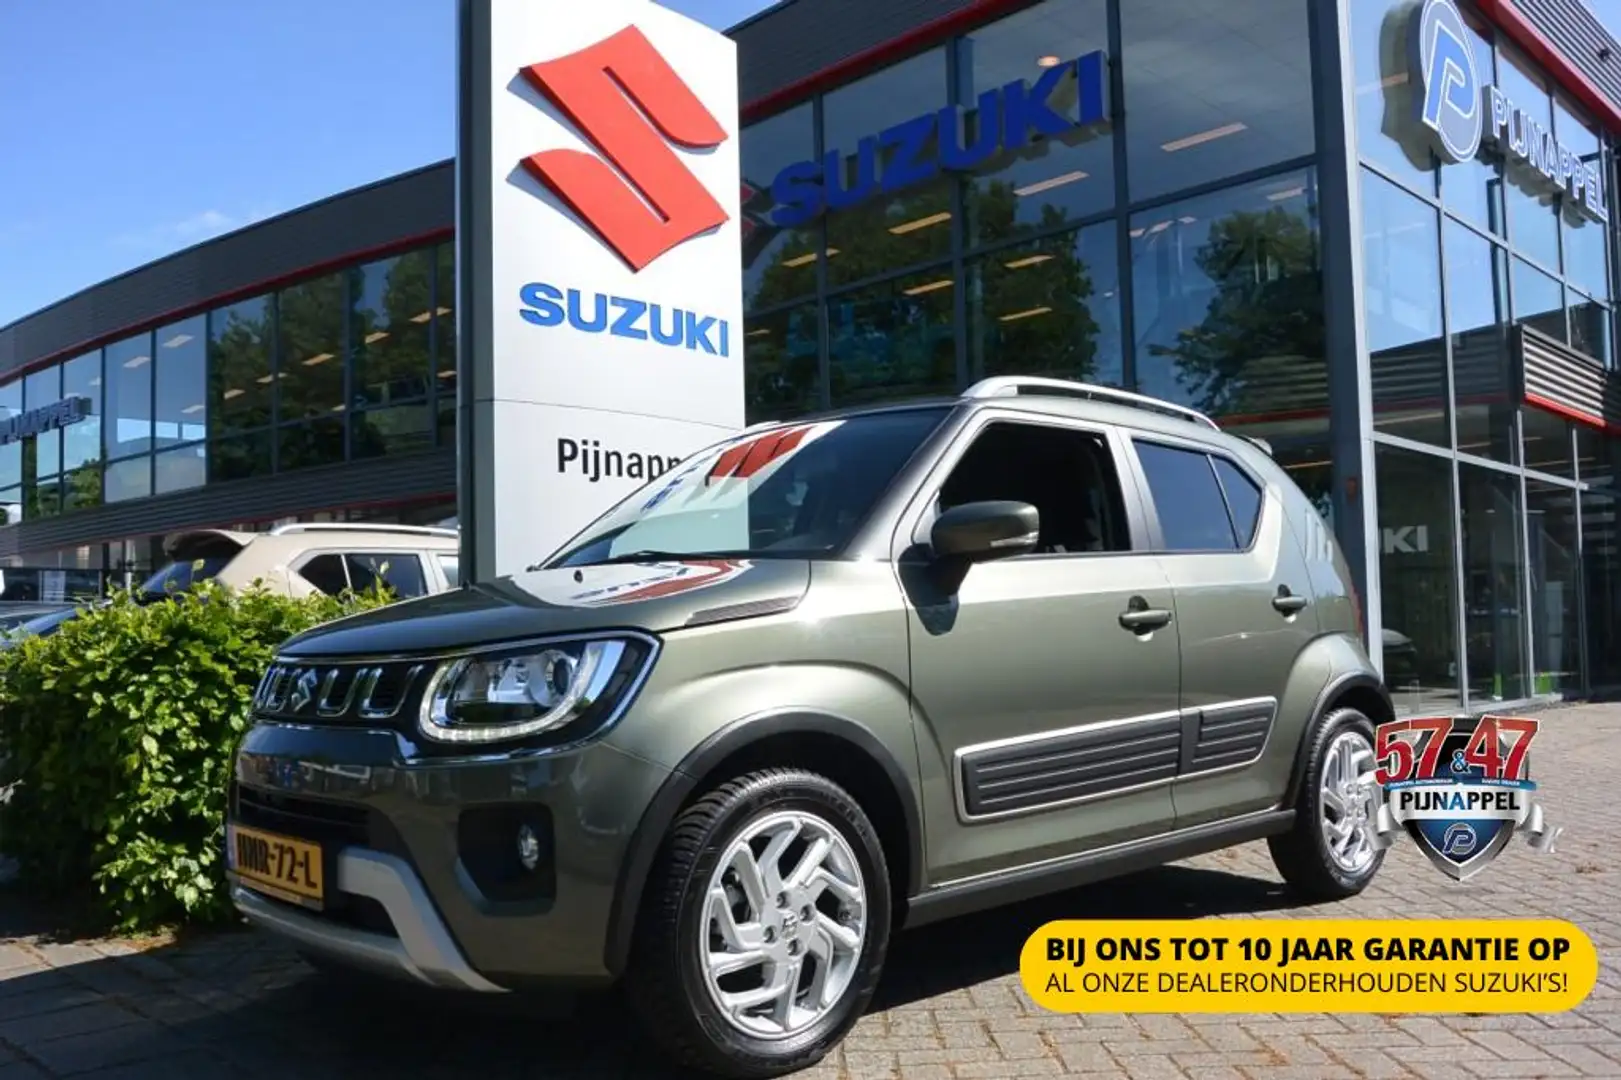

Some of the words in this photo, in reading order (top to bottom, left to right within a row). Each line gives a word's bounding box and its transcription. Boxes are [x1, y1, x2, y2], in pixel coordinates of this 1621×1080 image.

[771, 49, 1106, 228] SUZUKI
[1491, 85, 1608, 221] PIJNAPPEL
[518, 281, 730, 358] SUZUKI
